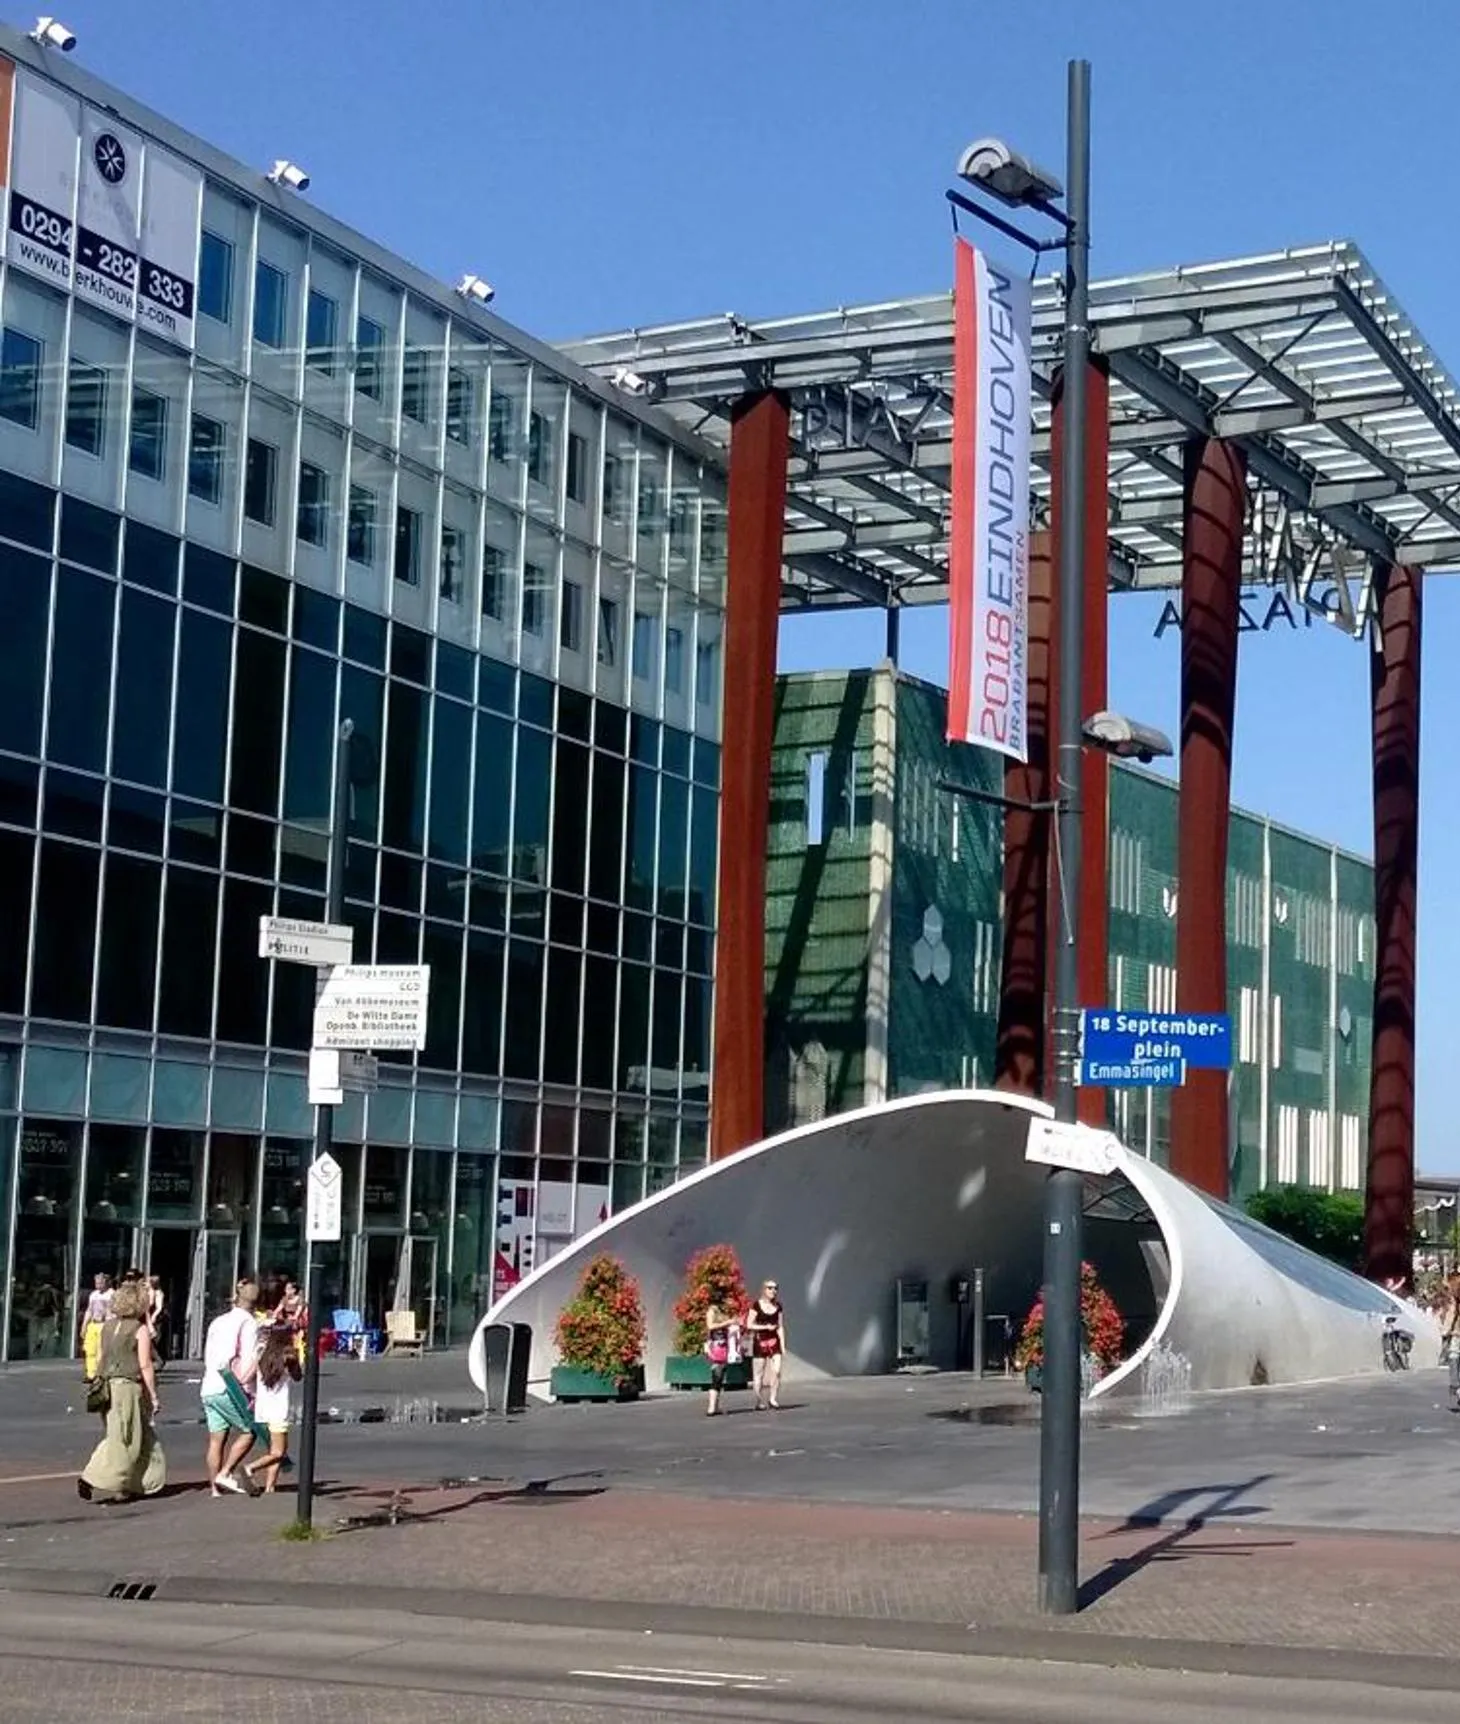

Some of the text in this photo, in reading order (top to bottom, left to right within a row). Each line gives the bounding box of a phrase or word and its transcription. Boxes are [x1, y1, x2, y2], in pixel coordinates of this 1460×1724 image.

[21, 204, 73, 251] 0294
[98, 244, 137, 286] 282
[149, 269, 185, 309] 333
[980, 264, 1015, 744] 2018 EINDHOVEN
[1092, 1015, 1225, 1037] 18 September-
[1134, 1041, 1182, 1060] plein
[1089, 1063, 1175, 1082] Emmasingel
